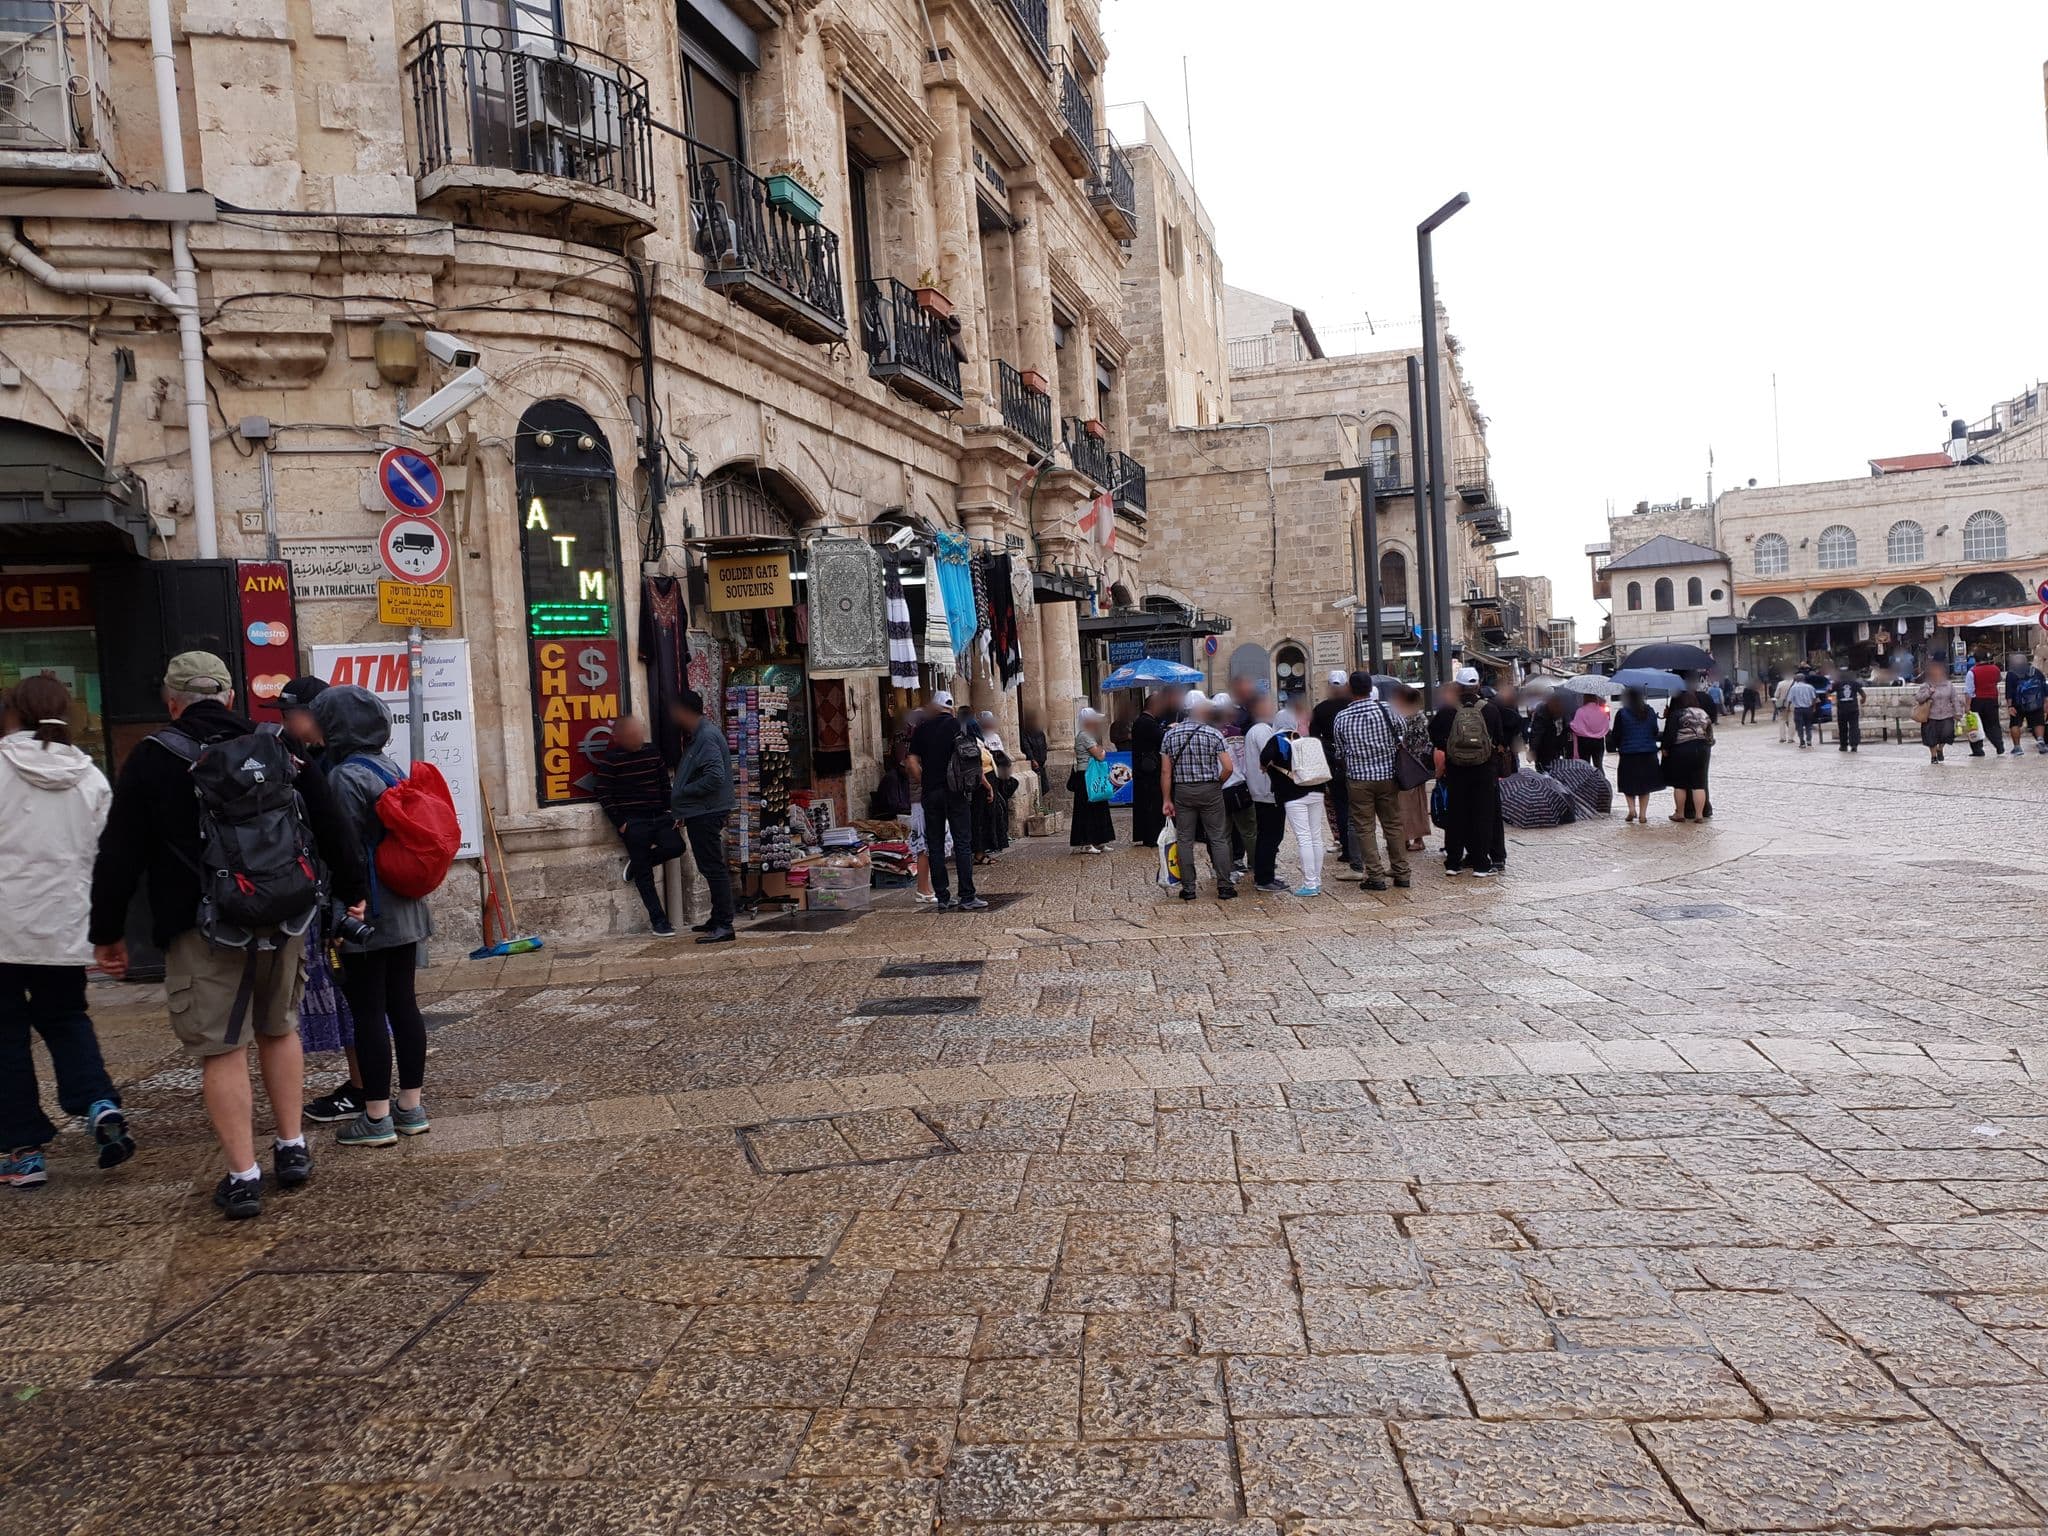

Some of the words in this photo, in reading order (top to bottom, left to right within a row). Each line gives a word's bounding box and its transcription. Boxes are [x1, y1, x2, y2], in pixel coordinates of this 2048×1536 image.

[244, 515, 260, 527] 57
[526, 498, 604, 600] ATM
[413, 558, 419, 566] 4
[719, 566, 754, 581] GOLDEN
[756, 564, 779, 578] GATE
[244, 576, 286, 592] ATM
[294, 585, 310, 597] TIN
[313, 583, 376, 597] PATRIARCHATE
[726, 582, 774, 598] SOUVENIRS
[0, 585, 80, 612] GER
[410, 608, 443, 618] AUTHORIZED
[250, 629, 286, 638] Maestro
[329, 653, 409, 692] ATM
[544, 694, 618, 721] ATM
[391, 713, 411, 724] tes
[432, 709, 462, 722] Cash
[540, 643, 571, 800] CHANGE
[431, 731, 449, 742] Sell
